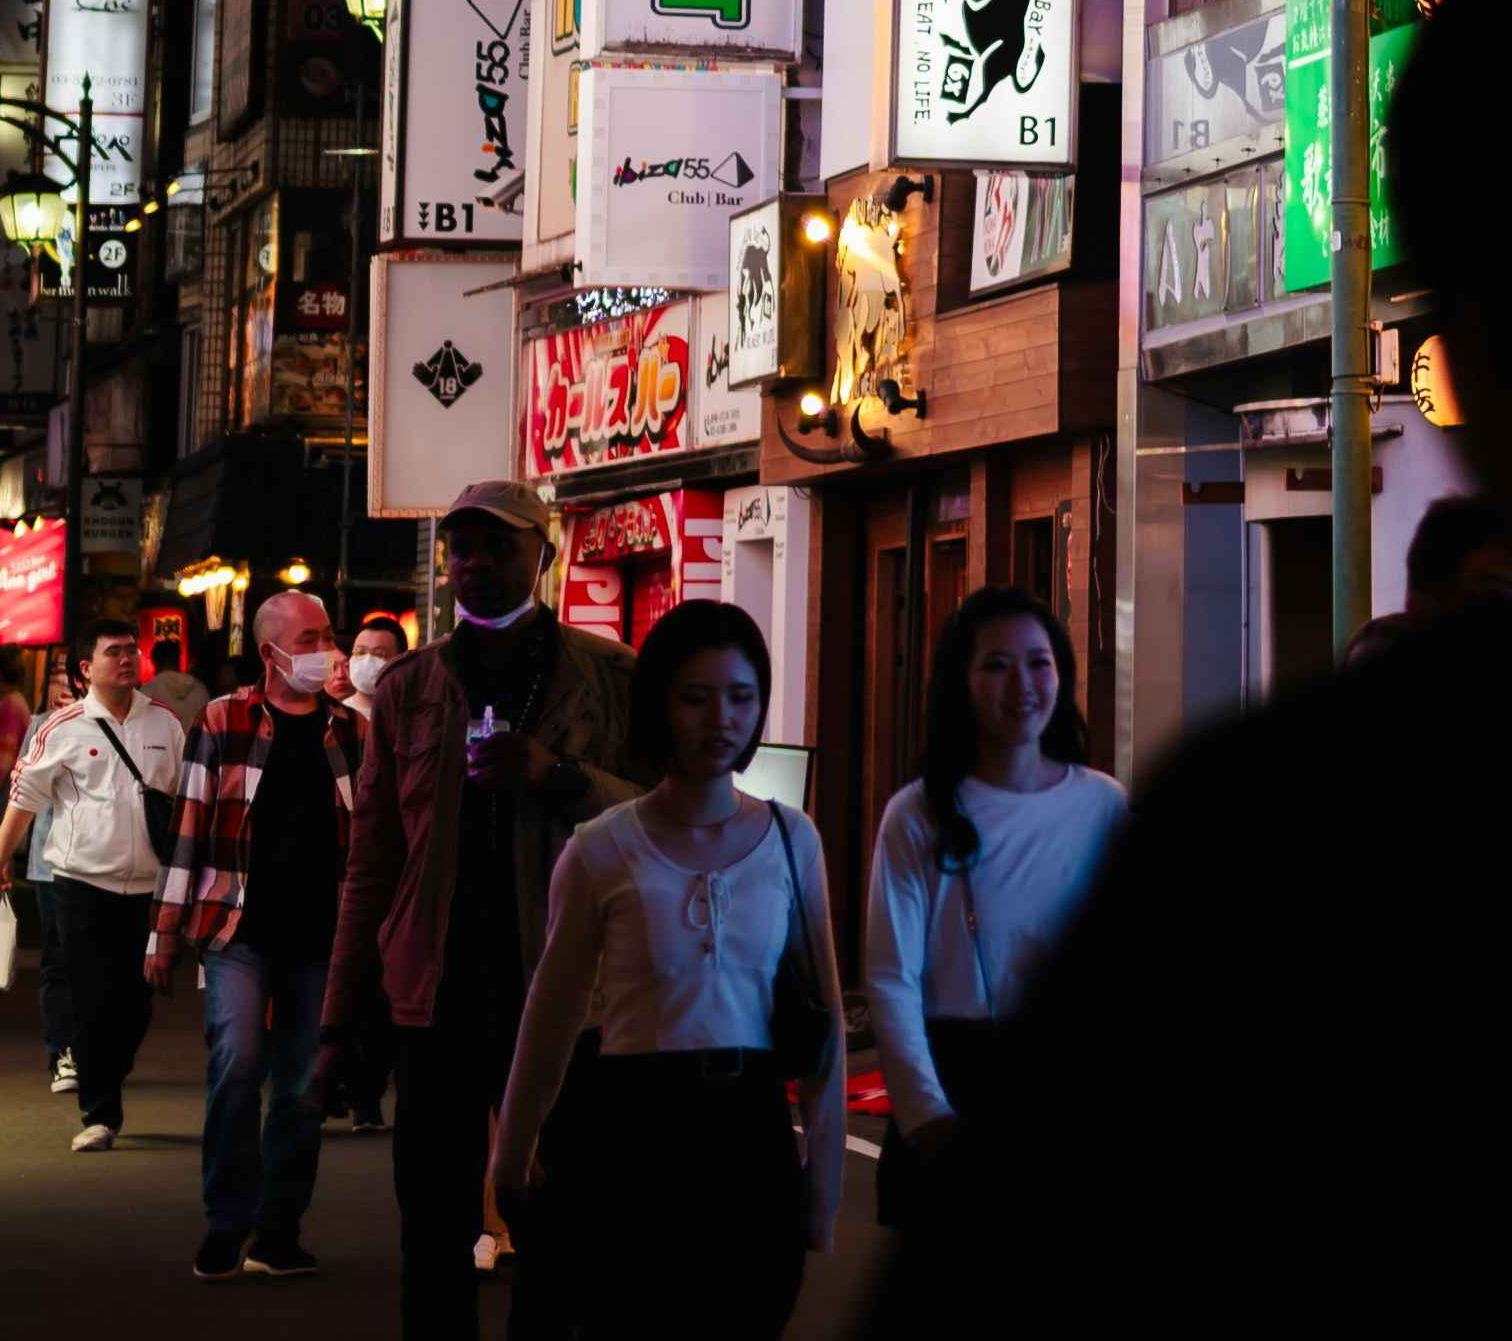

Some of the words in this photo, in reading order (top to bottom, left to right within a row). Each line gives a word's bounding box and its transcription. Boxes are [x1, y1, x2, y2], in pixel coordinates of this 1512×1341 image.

[917, 51, 931, 73] NO
[1019, 116, 1056, 146] B1
[667, 191, 704, 206] Club
[713, 191, 744, 207] Bar
[435, 203, 473, 233] B1
[105, 246, 122, 261] 2F
[298, 291, 346, 316] 名物
[439, 377, 457, 394] 18
